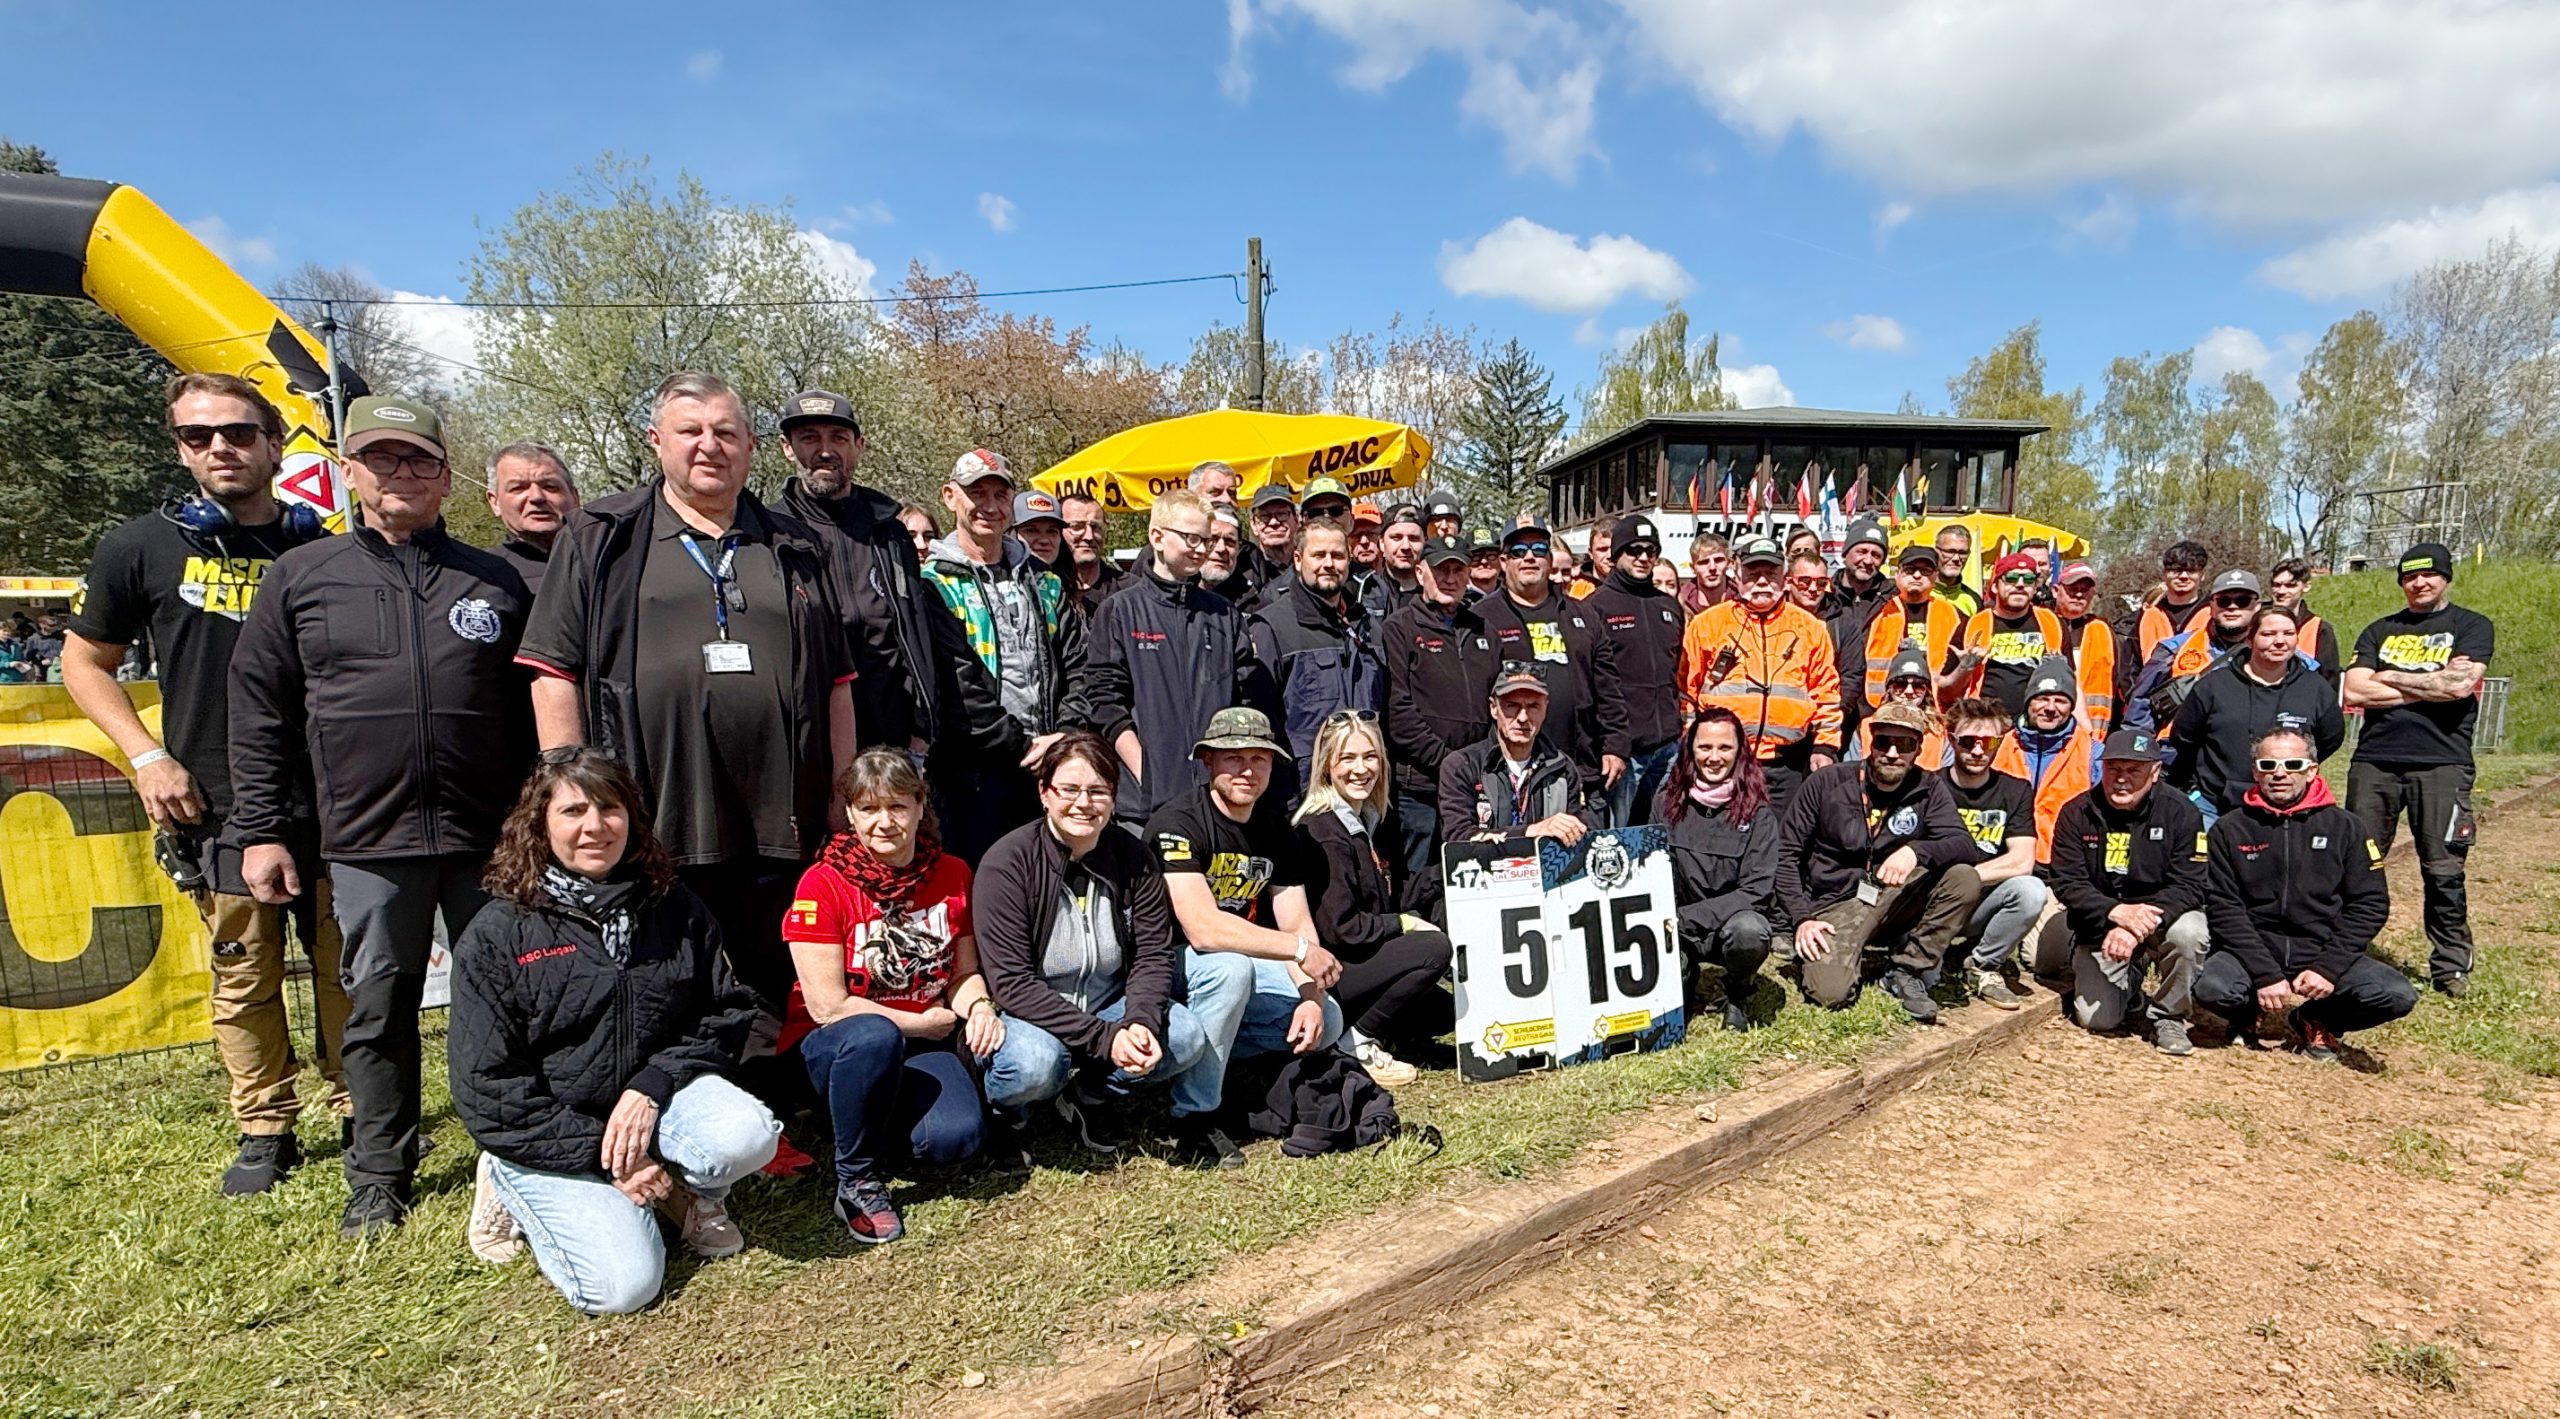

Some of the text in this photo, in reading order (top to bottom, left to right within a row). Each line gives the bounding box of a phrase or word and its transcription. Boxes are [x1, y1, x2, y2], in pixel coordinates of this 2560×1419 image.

[1308, 437, 1378, 478] ADAC
[1211, 877, 1269, 899] UGAU
[543, 944, 577, 957] Lugau
[1501, 906, 1549, 998] 5
[1569, 894, 1660, 1004] 15
